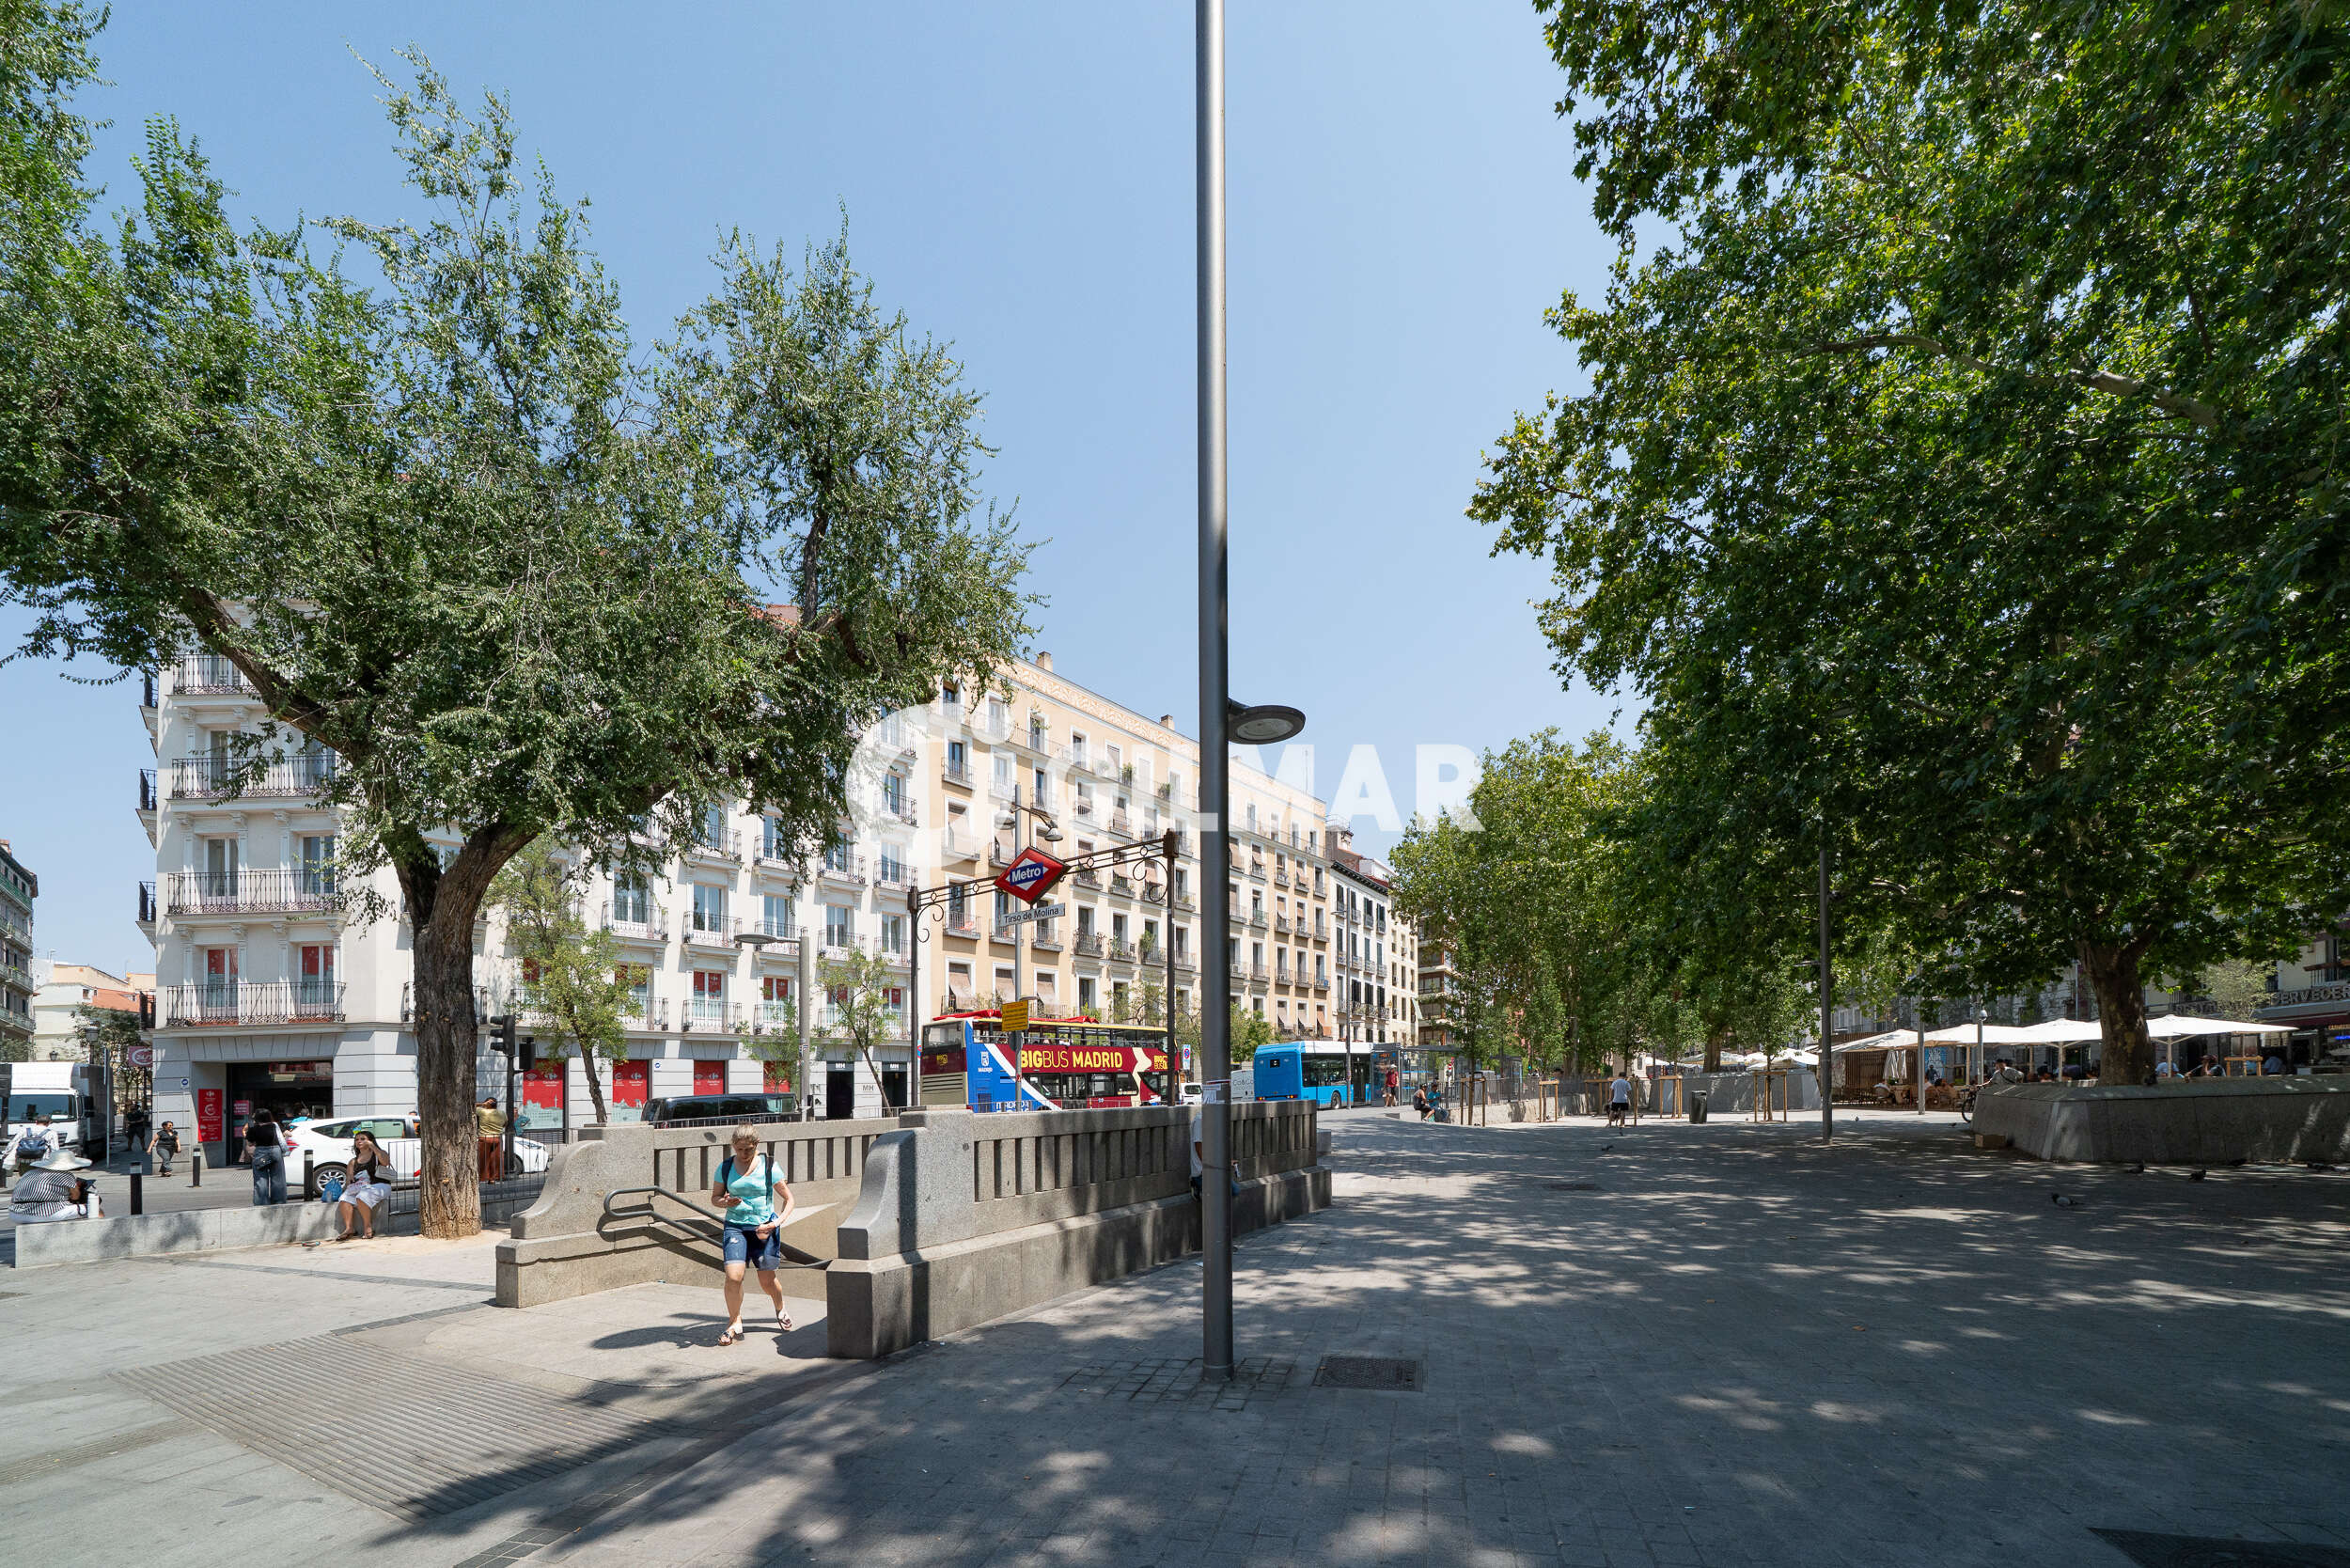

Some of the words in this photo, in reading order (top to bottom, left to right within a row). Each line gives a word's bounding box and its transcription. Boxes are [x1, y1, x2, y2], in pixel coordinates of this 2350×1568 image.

[1011, 867, 1042, 883] Metro
[1005, 915, 1022, 924] Tirso
[1023, 912, 1032, 920] de
[1034, 907, 1059, 918] Molina
[1073, 1051, 1123, 1069] MADRID
